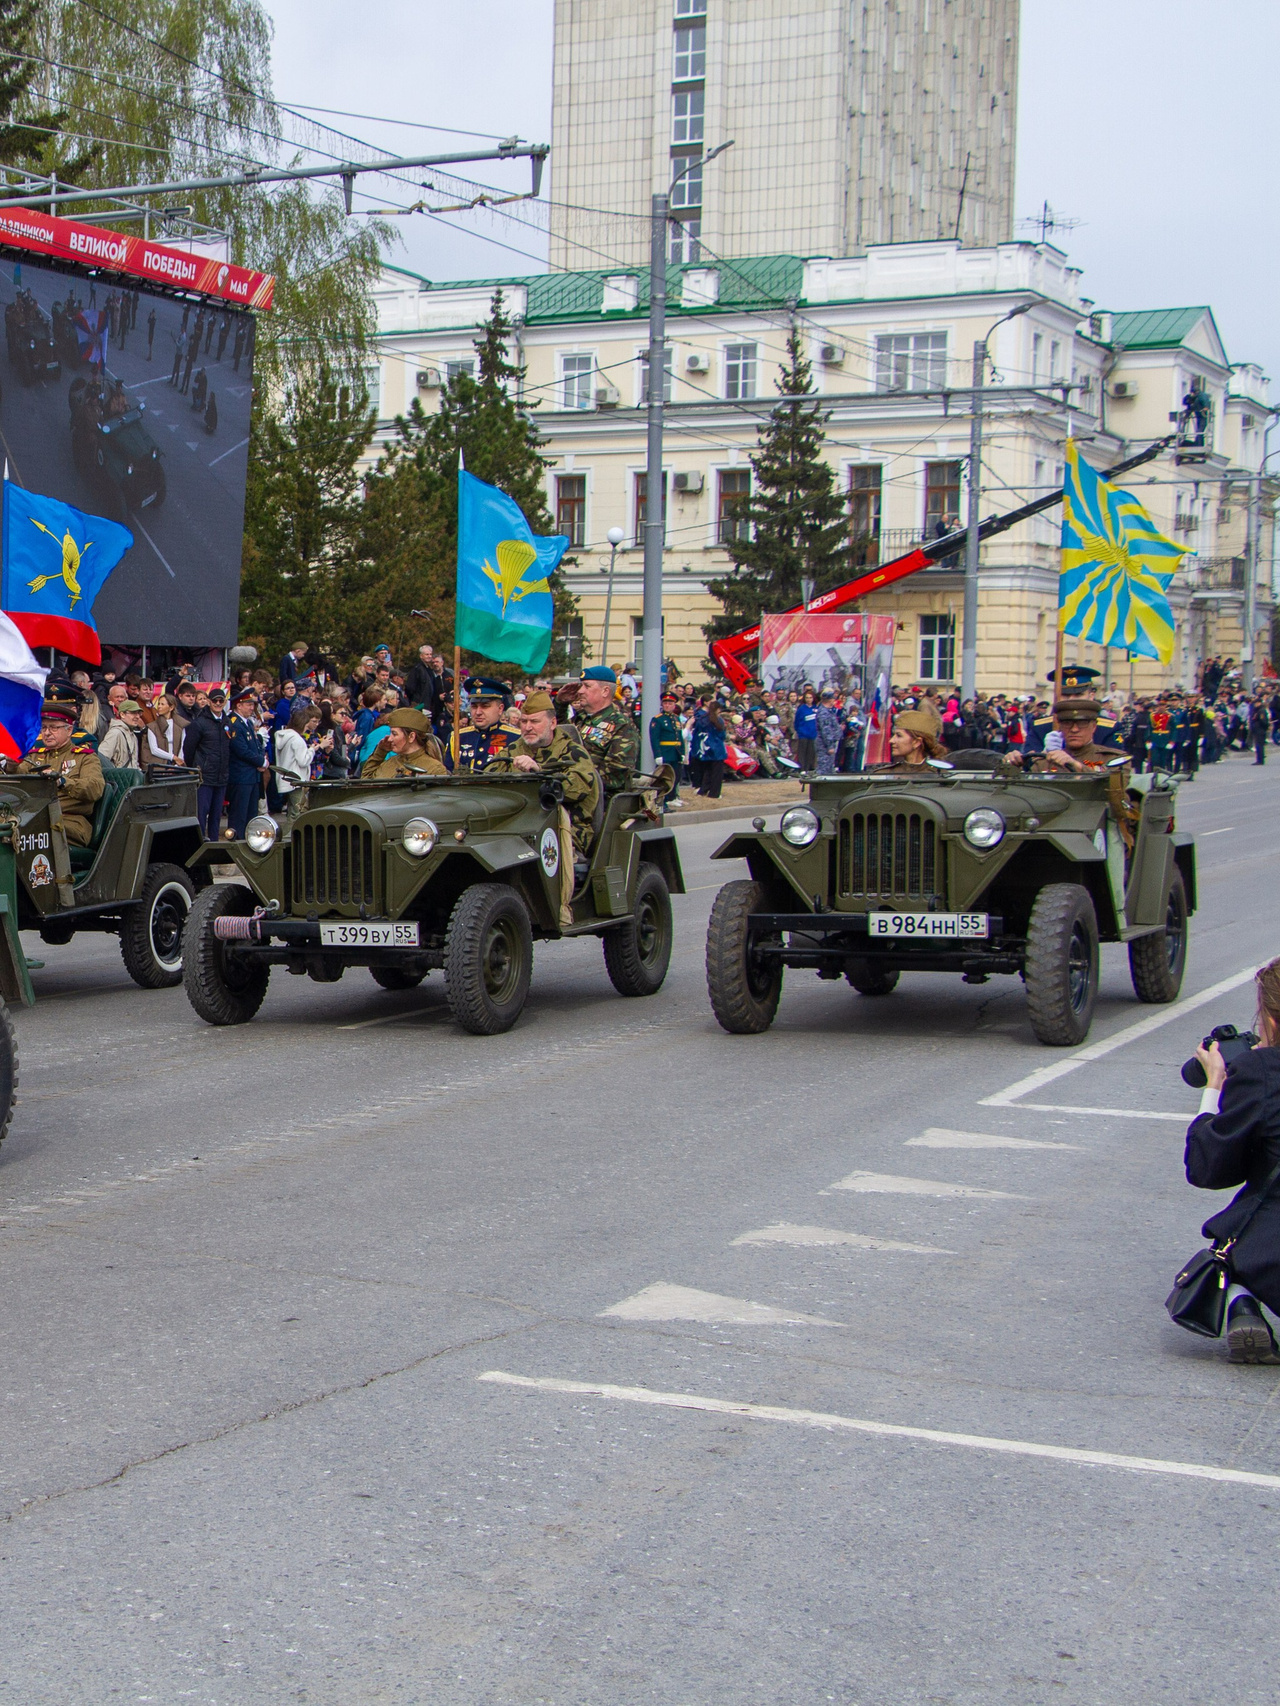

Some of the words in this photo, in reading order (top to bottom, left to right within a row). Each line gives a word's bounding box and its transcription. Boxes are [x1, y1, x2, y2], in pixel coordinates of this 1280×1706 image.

[70, 231, 128, 263] ВЕЛИКОЙ
[143, 250, 197, 281] ПОБЕДЫ!
[229, 278, 249, 296] МАЯ
[960, 915, 980, 930] 55
[395, 925, 412, 938] 55
